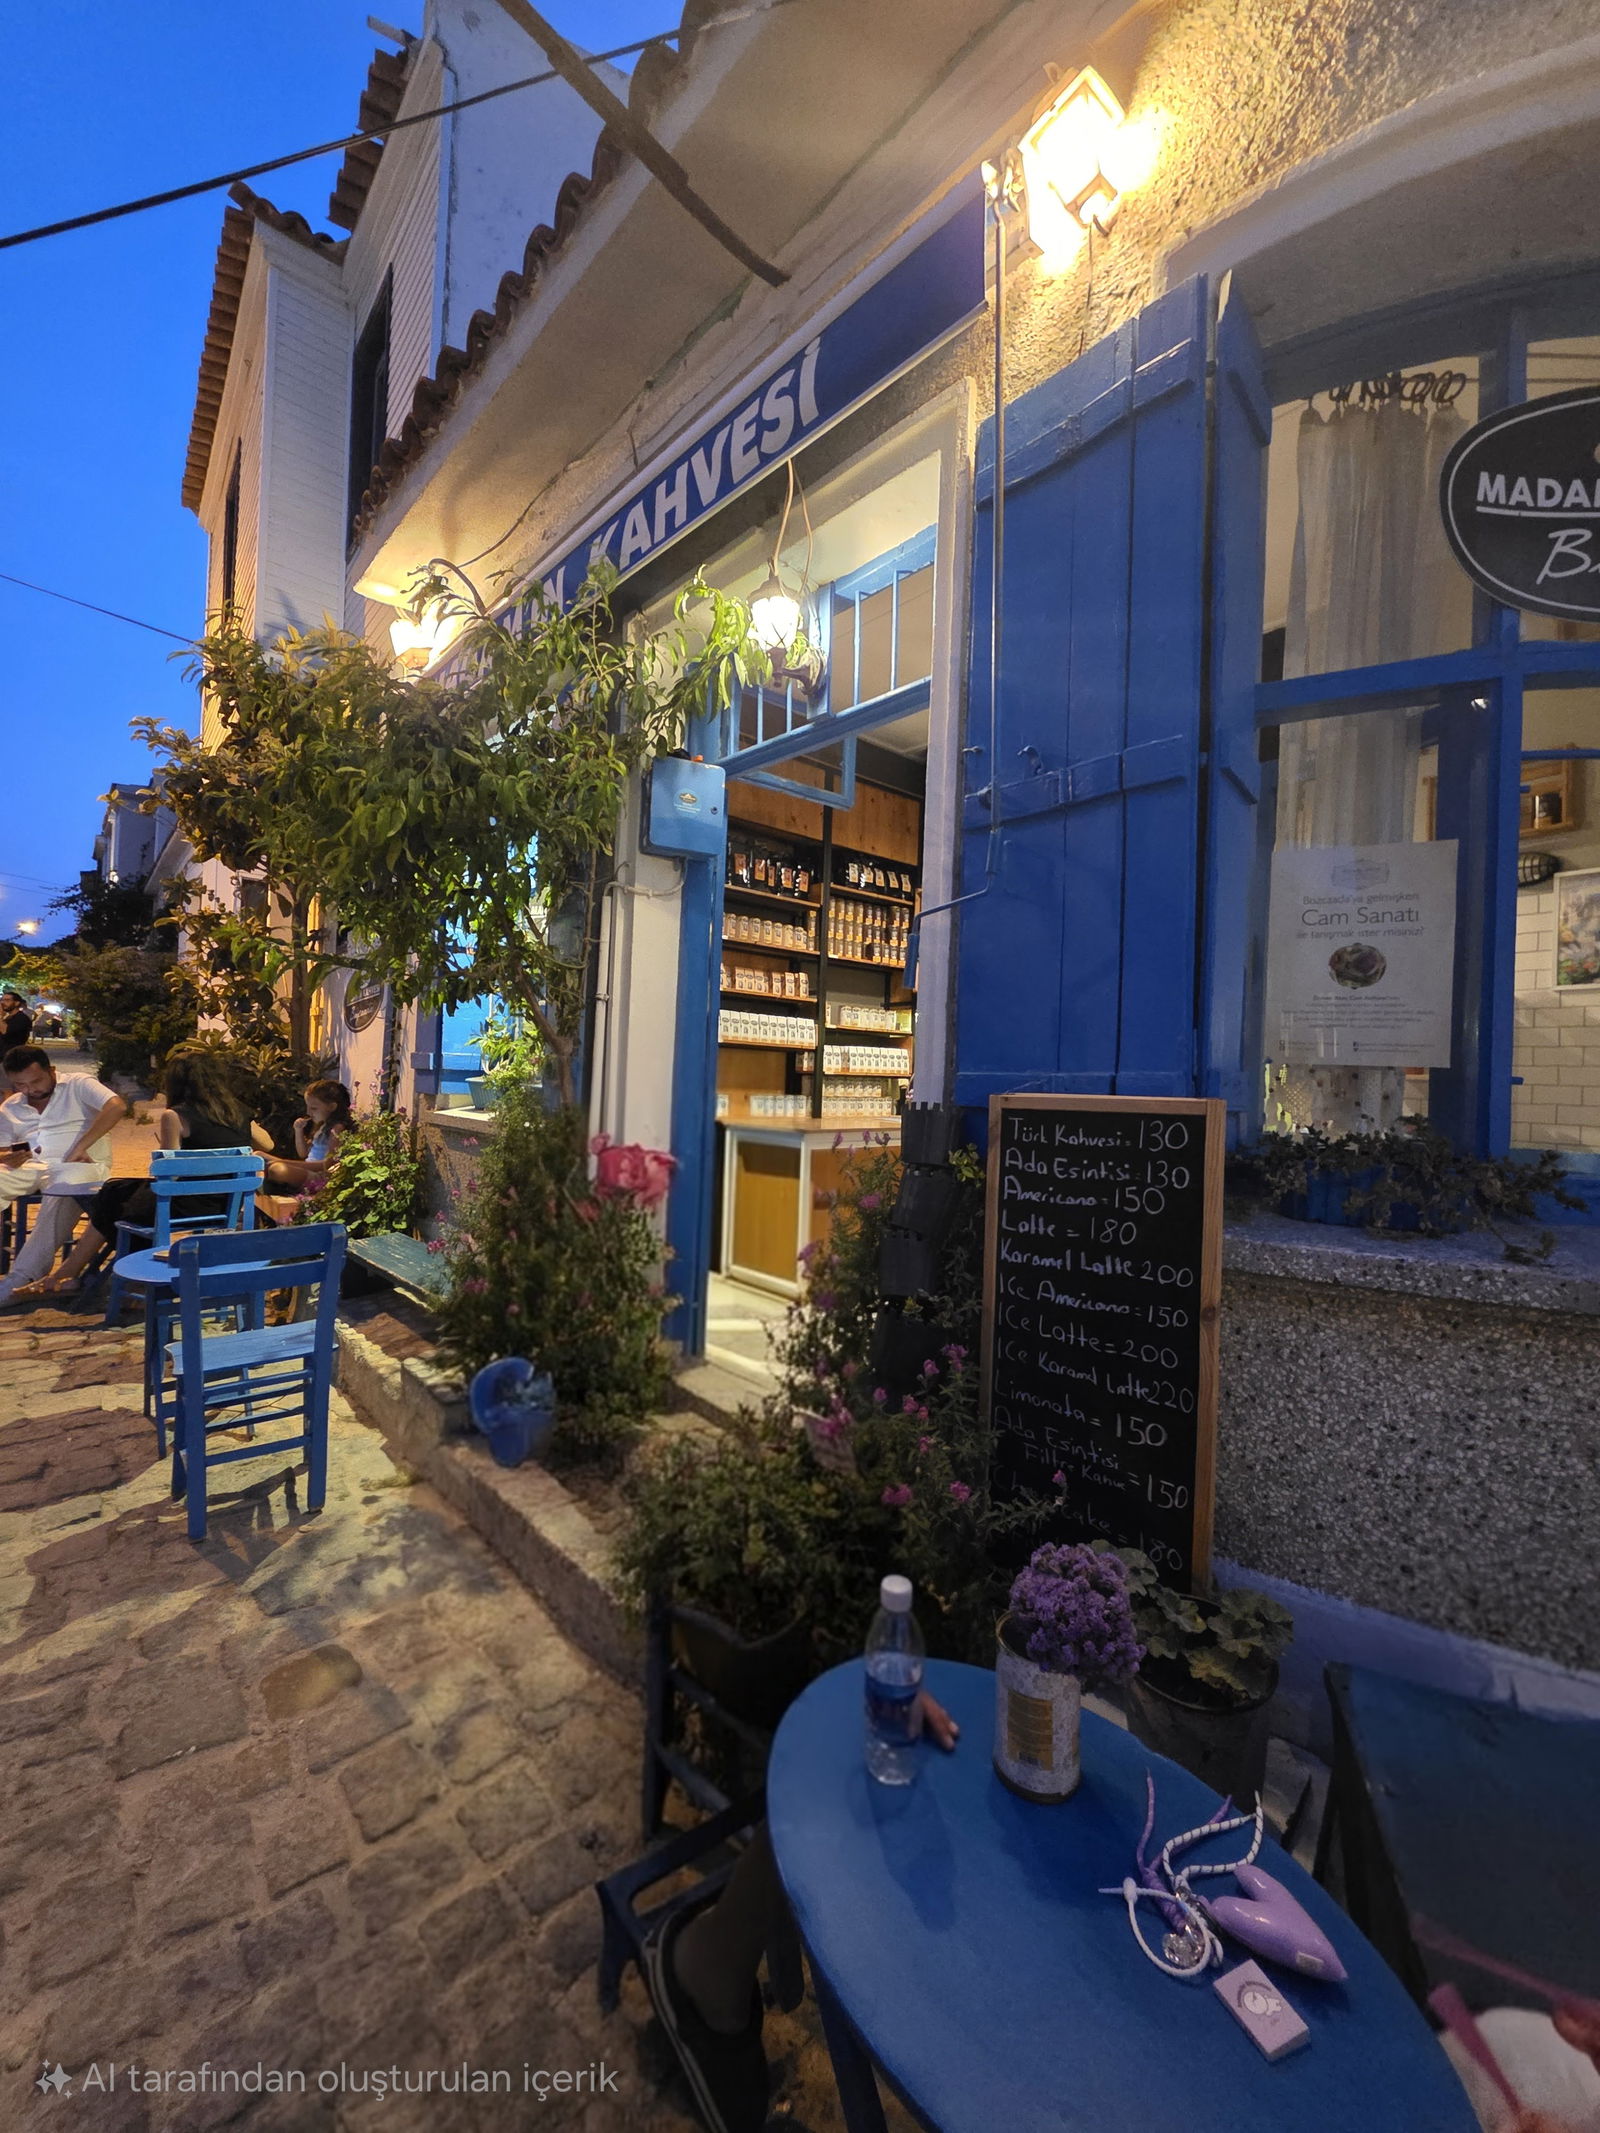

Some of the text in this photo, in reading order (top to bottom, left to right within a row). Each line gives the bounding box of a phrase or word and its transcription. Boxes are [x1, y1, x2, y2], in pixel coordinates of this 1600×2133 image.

[588, 336, 822, 572] KAHVESİ
[1476, 471, 1600, 508] MADA
[1536, 528, 1600, 585] B
[1301, 906, 1419, 927] Cam Sanatı
[1138, 1119, 1189, 1152] 130
[1005, 1146, 1048, 1175] Ada
[1053, 1156, 1131, 1181] Esintisi
[1147, 1160, 1191, 1189] 130
[1003, 1174, 1098, 1206] Americano
[1114, 1186, 1166, 1215] 150
[1001, 1208, 1057, 1238] Latte
[1090, 1216, 1137, 1246] 180
[1000, 1237, 1194, 1288] Karamel Latte 200
[1036, 1279, 1131, 1314] Americano
[1148, 1304, 1190, 1328] 150
[1039, 1314, 1103, 1353] Latte
[1121, 1338, 1179, 1369] 200
[994, 1368, 1086, 1424] Limonata
[1115, 1412, 1169, 1447] 150
[1147, 1379, 1195, 1414] 220
[994, 1404, 1120, 1470] Ada Esintisi
[1147, 1472, 1190, 1509] 150
[1139, 1529, 1184, 1571] 180
